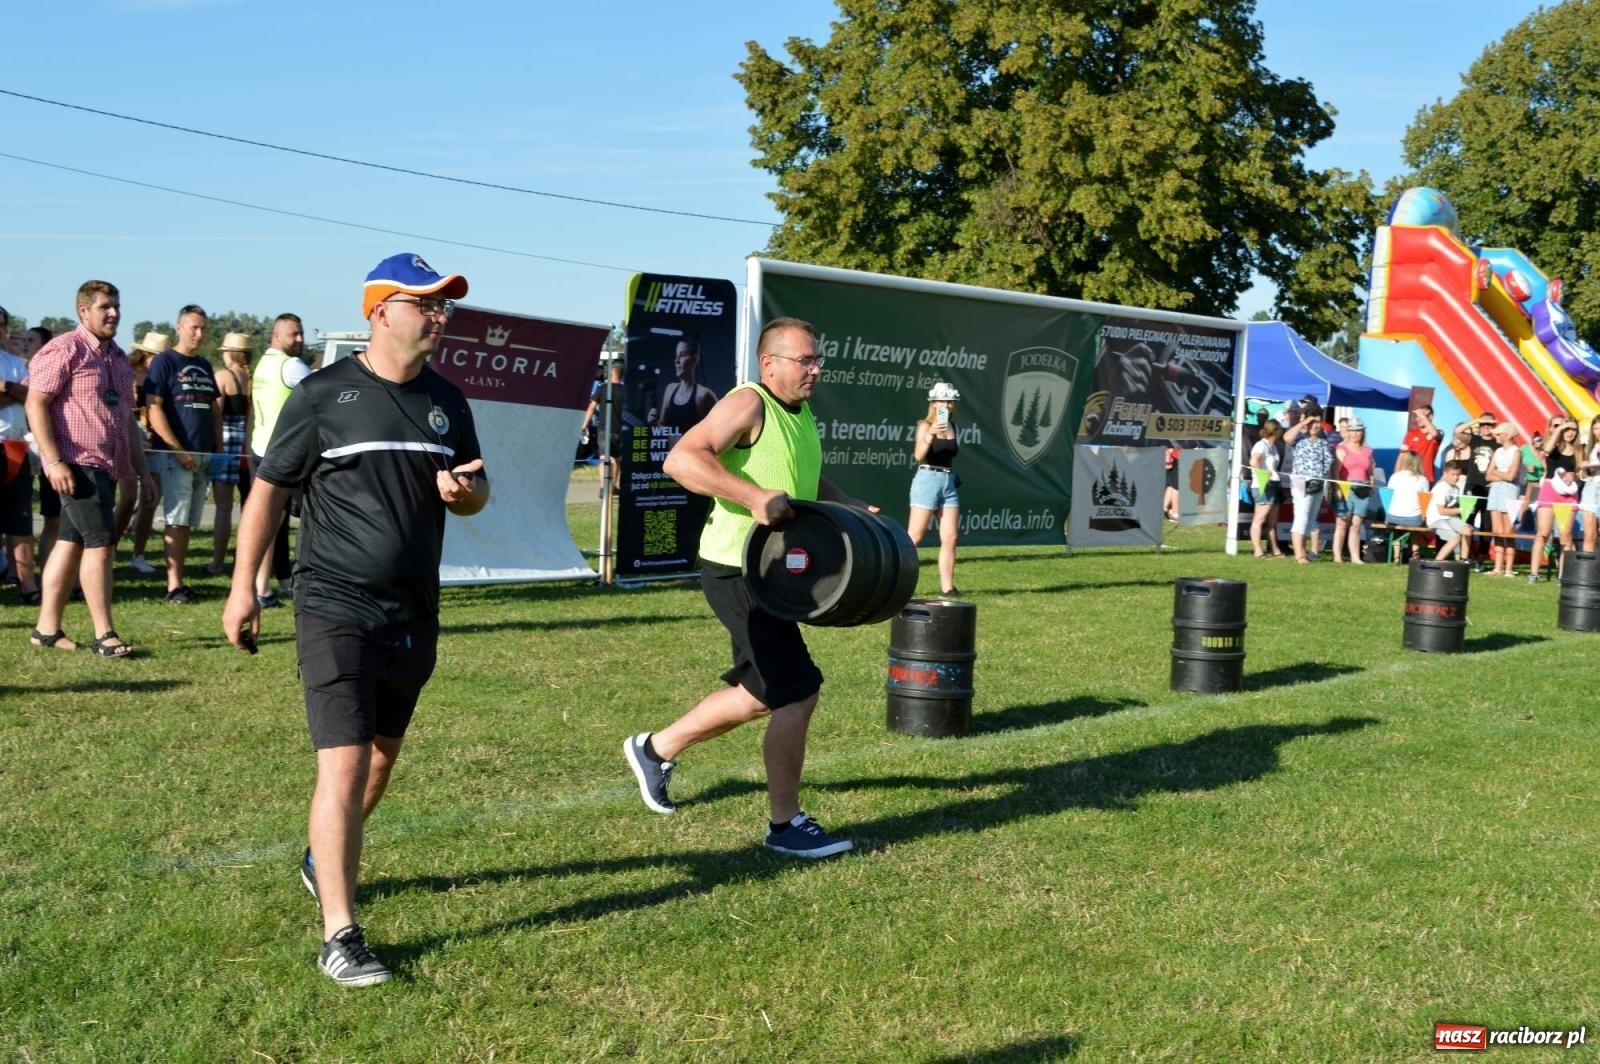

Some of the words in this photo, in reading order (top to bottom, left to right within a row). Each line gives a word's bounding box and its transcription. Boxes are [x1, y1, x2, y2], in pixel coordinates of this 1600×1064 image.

[662, 282, 706, 299] WELL
[655, 298, 724, 316] FITNESS
[1100, 325, 1129, 340] STUDIO
[1178, 333, 1230, 348] POLEROWANIA
[425, 347, 557, 378] ICTORIA
[842, 336, 851, 358] i
[853, 337, 916, 369] krzewy
[918, 345, 988, 370] ozdobne
[858, 369, 905, 391] stromy
[905, 375, 914, 389] a
[633, 427, 648, 437] BE
[651, 426, 682, 437] WELL
[831, 418, 904, 441] terenów
[1167, 418, 1185, 432] 503
[632, 440, 648, 449] BE
[650, 439, 668, 449] FIT
[632, 452, 647, 462] BE
[852, 447, 907, 469] zelených
